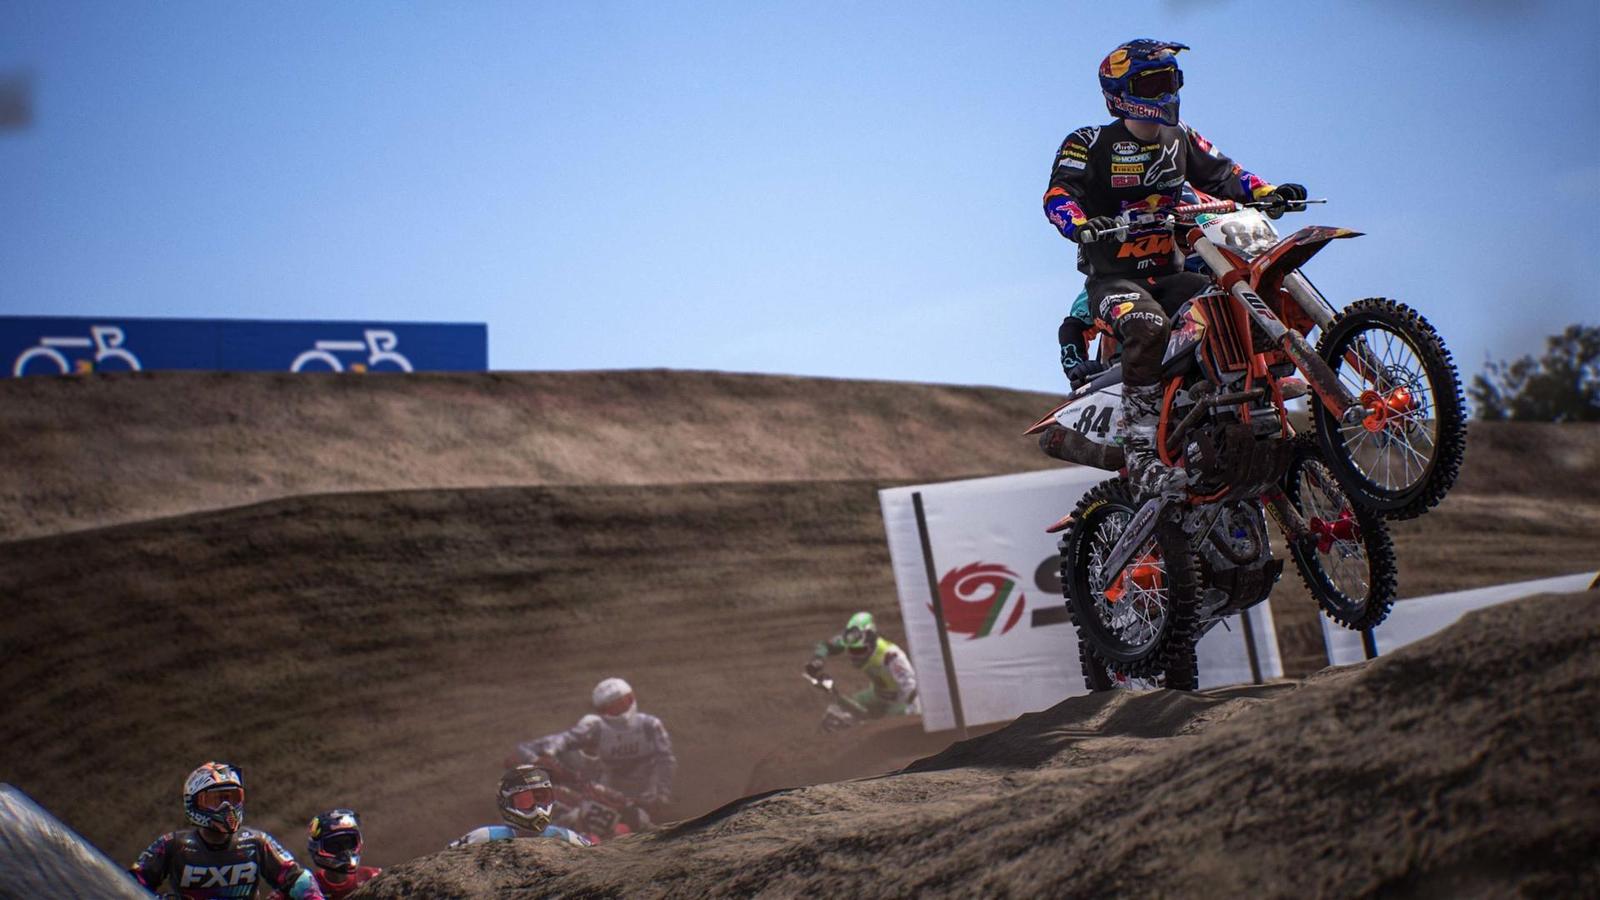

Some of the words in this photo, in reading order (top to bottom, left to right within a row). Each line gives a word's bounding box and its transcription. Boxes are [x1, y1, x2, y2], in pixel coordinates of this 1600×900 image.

[1116, 233, 1174, 258] KTM
[1077, 404, 1114, 438] 84
[180, 861, 258, 888] FXR
